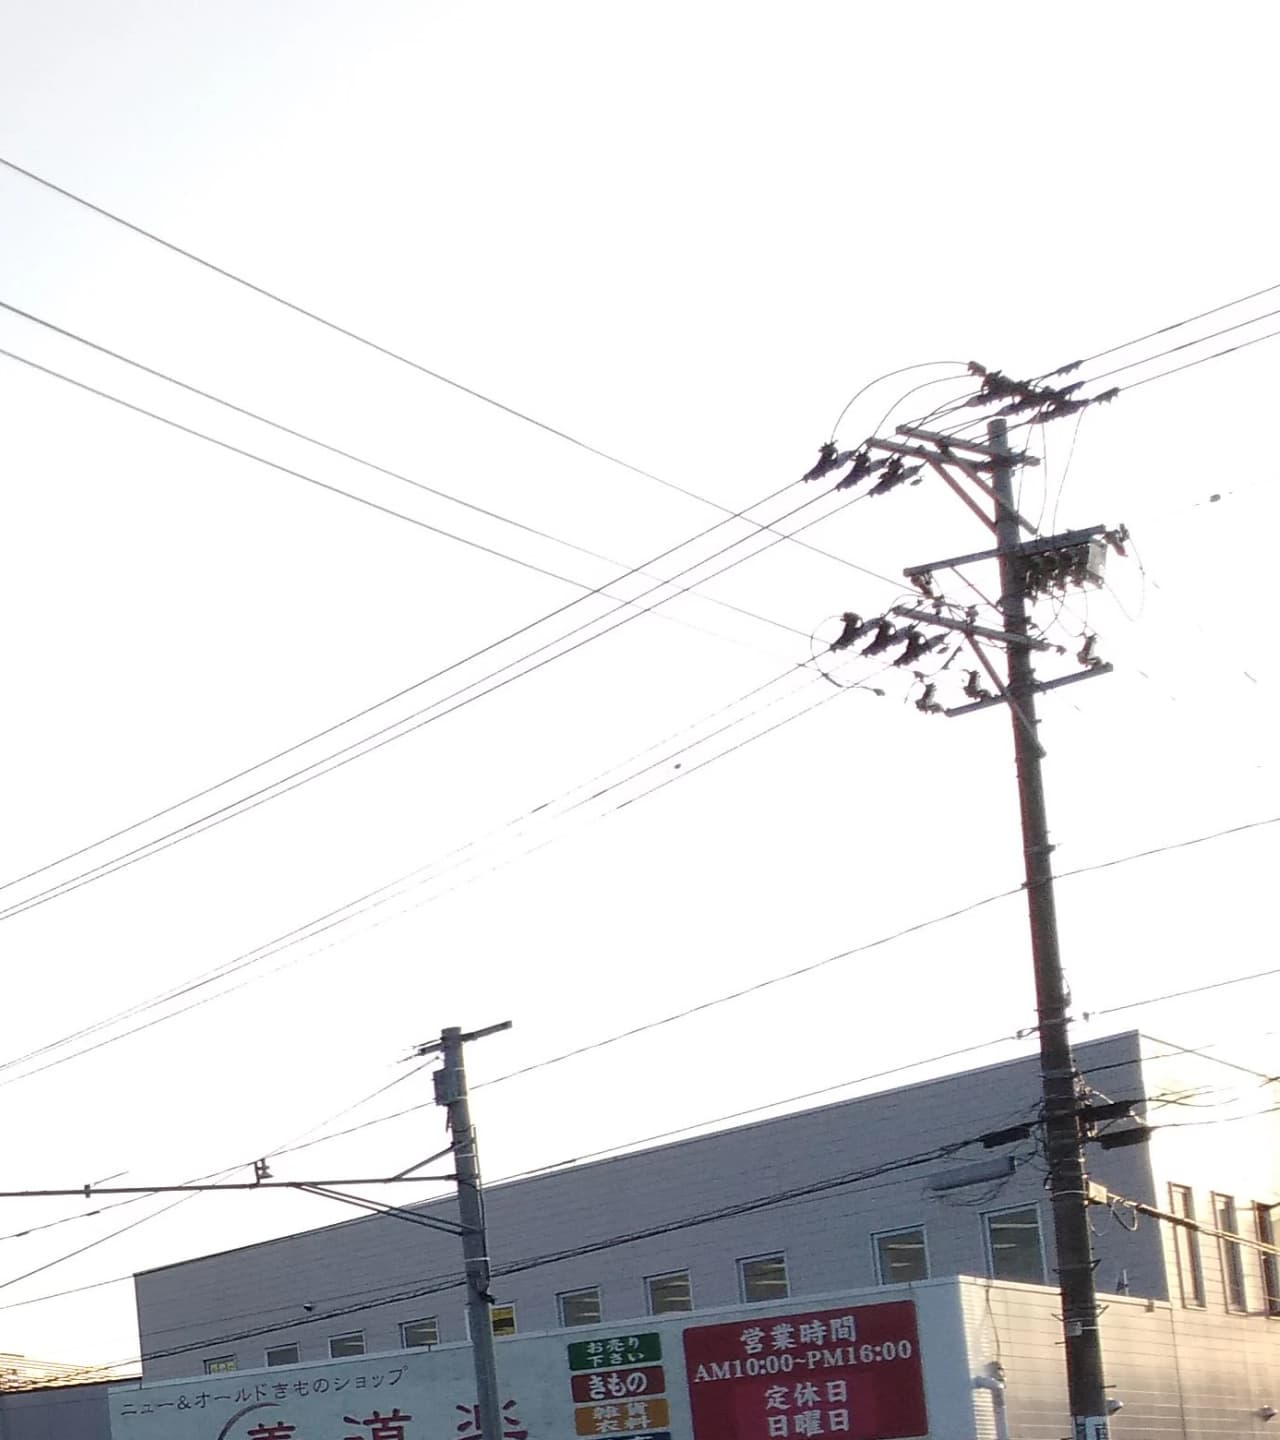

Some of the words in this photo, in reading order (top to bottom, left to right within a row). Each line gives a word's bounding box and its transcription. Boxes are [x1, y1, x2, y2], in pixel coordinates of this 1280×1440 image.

[739, 1315, 857, 1354] 営業時間
[588, 1372, 648, 1400] きもの
[763, 1379, 849, 1411] 定休日
[766, 1408, 850, 1439] 日曜日
